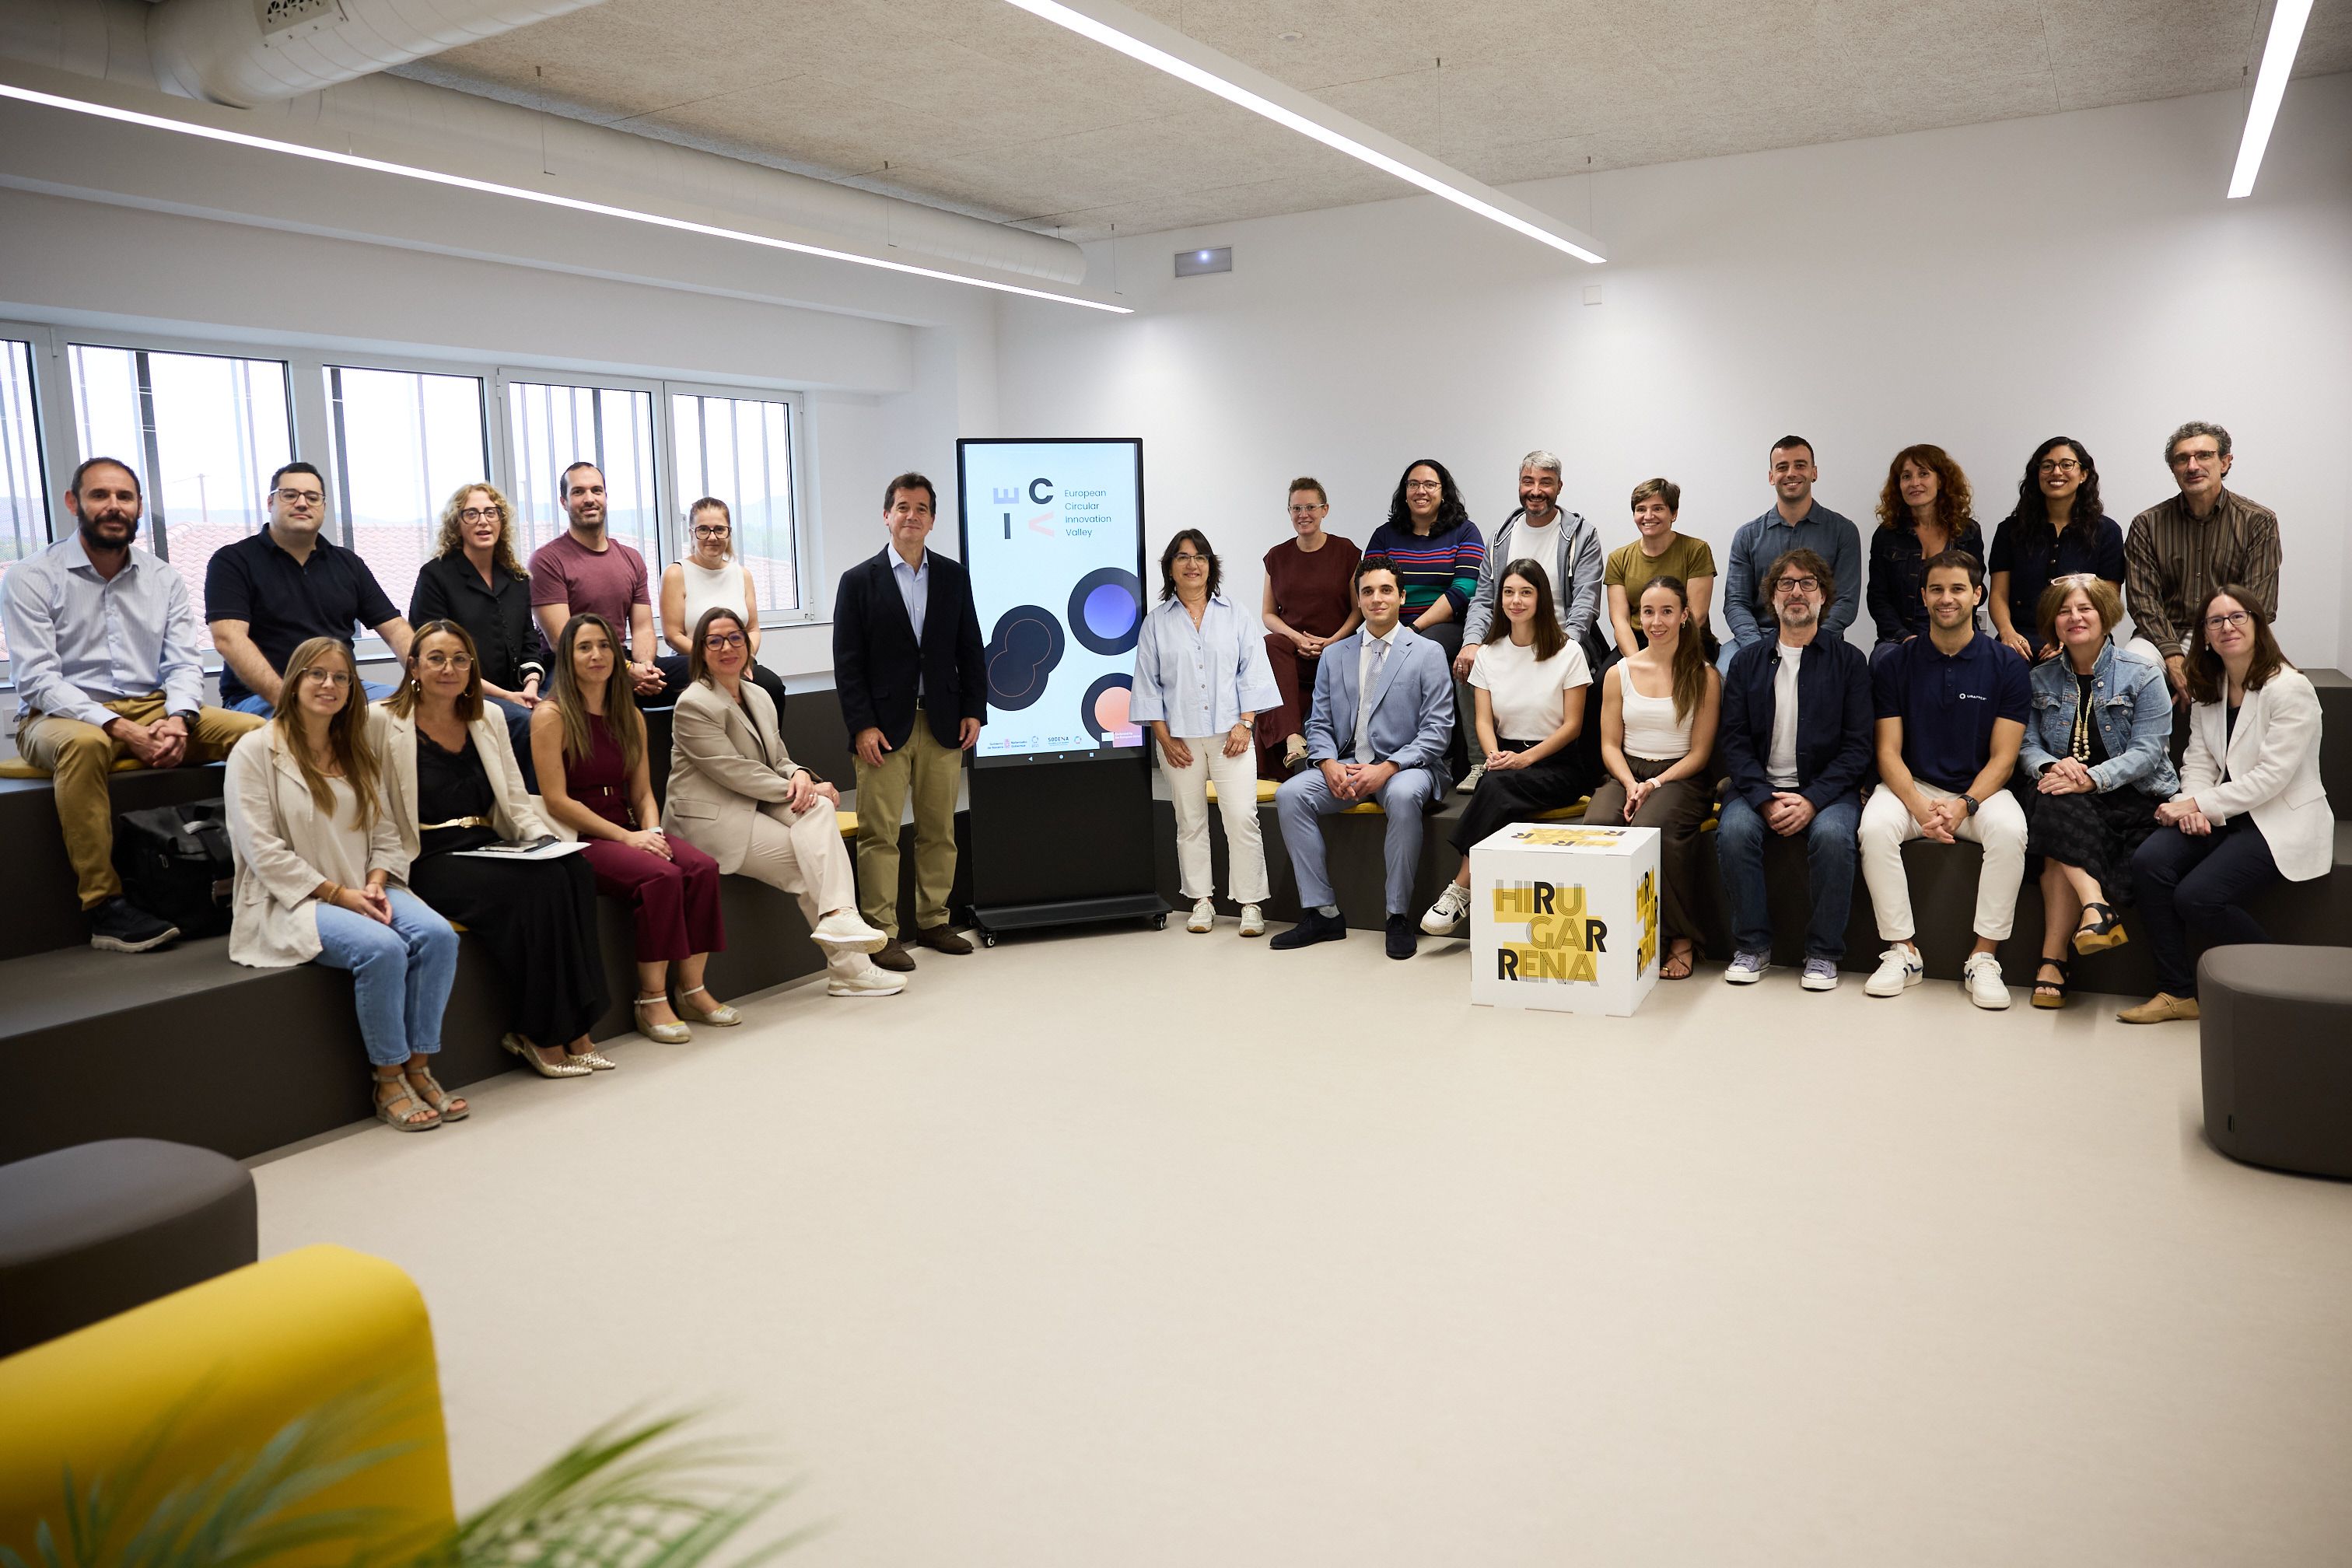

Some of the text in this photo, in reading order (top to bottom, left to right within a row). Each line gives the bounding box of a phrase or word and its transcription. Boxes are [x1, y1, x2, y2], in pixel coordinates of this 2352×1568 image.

[1029, 478, 1054, 505] C
[1065, 489, 1106, 499] European
[1066, 515, 1111, 523] Innovation
[1066, 528, 1093, 538] Valley
[1496, 879, 1582, 916] HIRU
[1526, 915, 1608, 953] GAR
[1498, 948, 1599, 987] RENA
